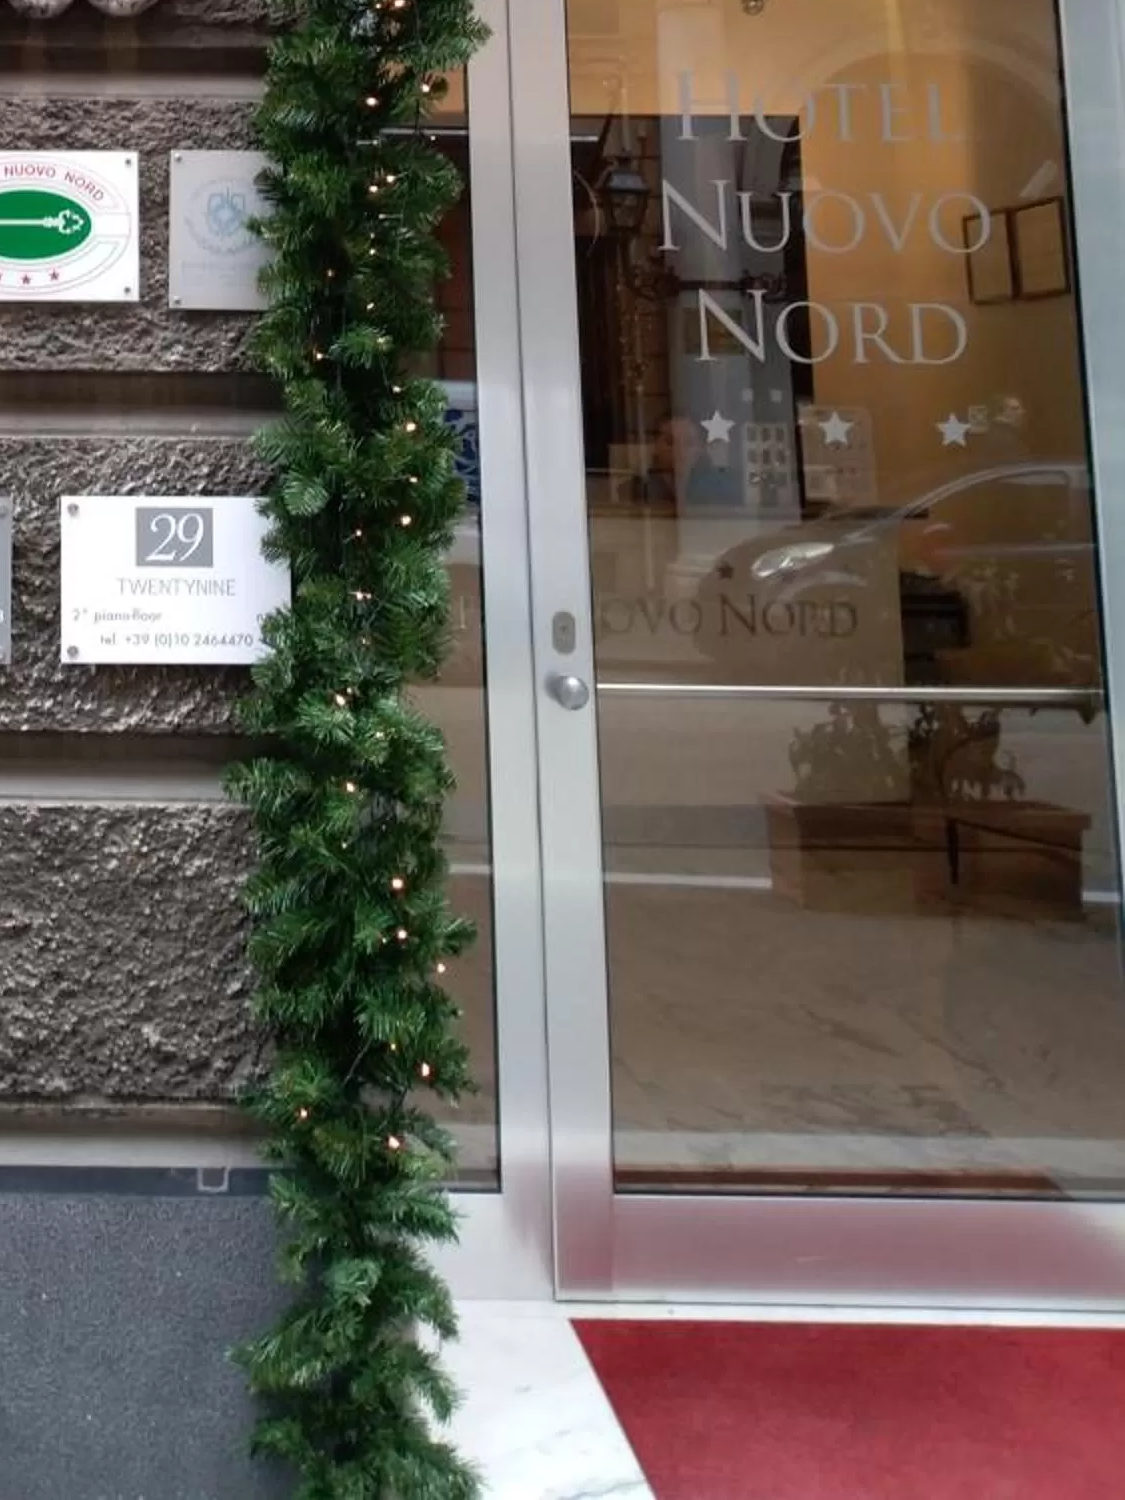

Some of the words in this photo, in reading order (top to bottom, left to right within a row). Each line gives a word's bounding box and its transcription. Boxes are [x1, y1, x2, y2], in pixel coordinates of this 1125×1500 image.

[676, 68, 969, 143] HOTEL
[3, 164, 57, 180] NUOVO
[63, 171, 105, 203] NORD
[658, 179, 992, 254] NUOVO
[694, 288, 969, 365] NORD
[145, 512, 205, 562] 29
[115, 577, 236, 598] TWENTYNINE
[124, 633, 151, 646] +39
